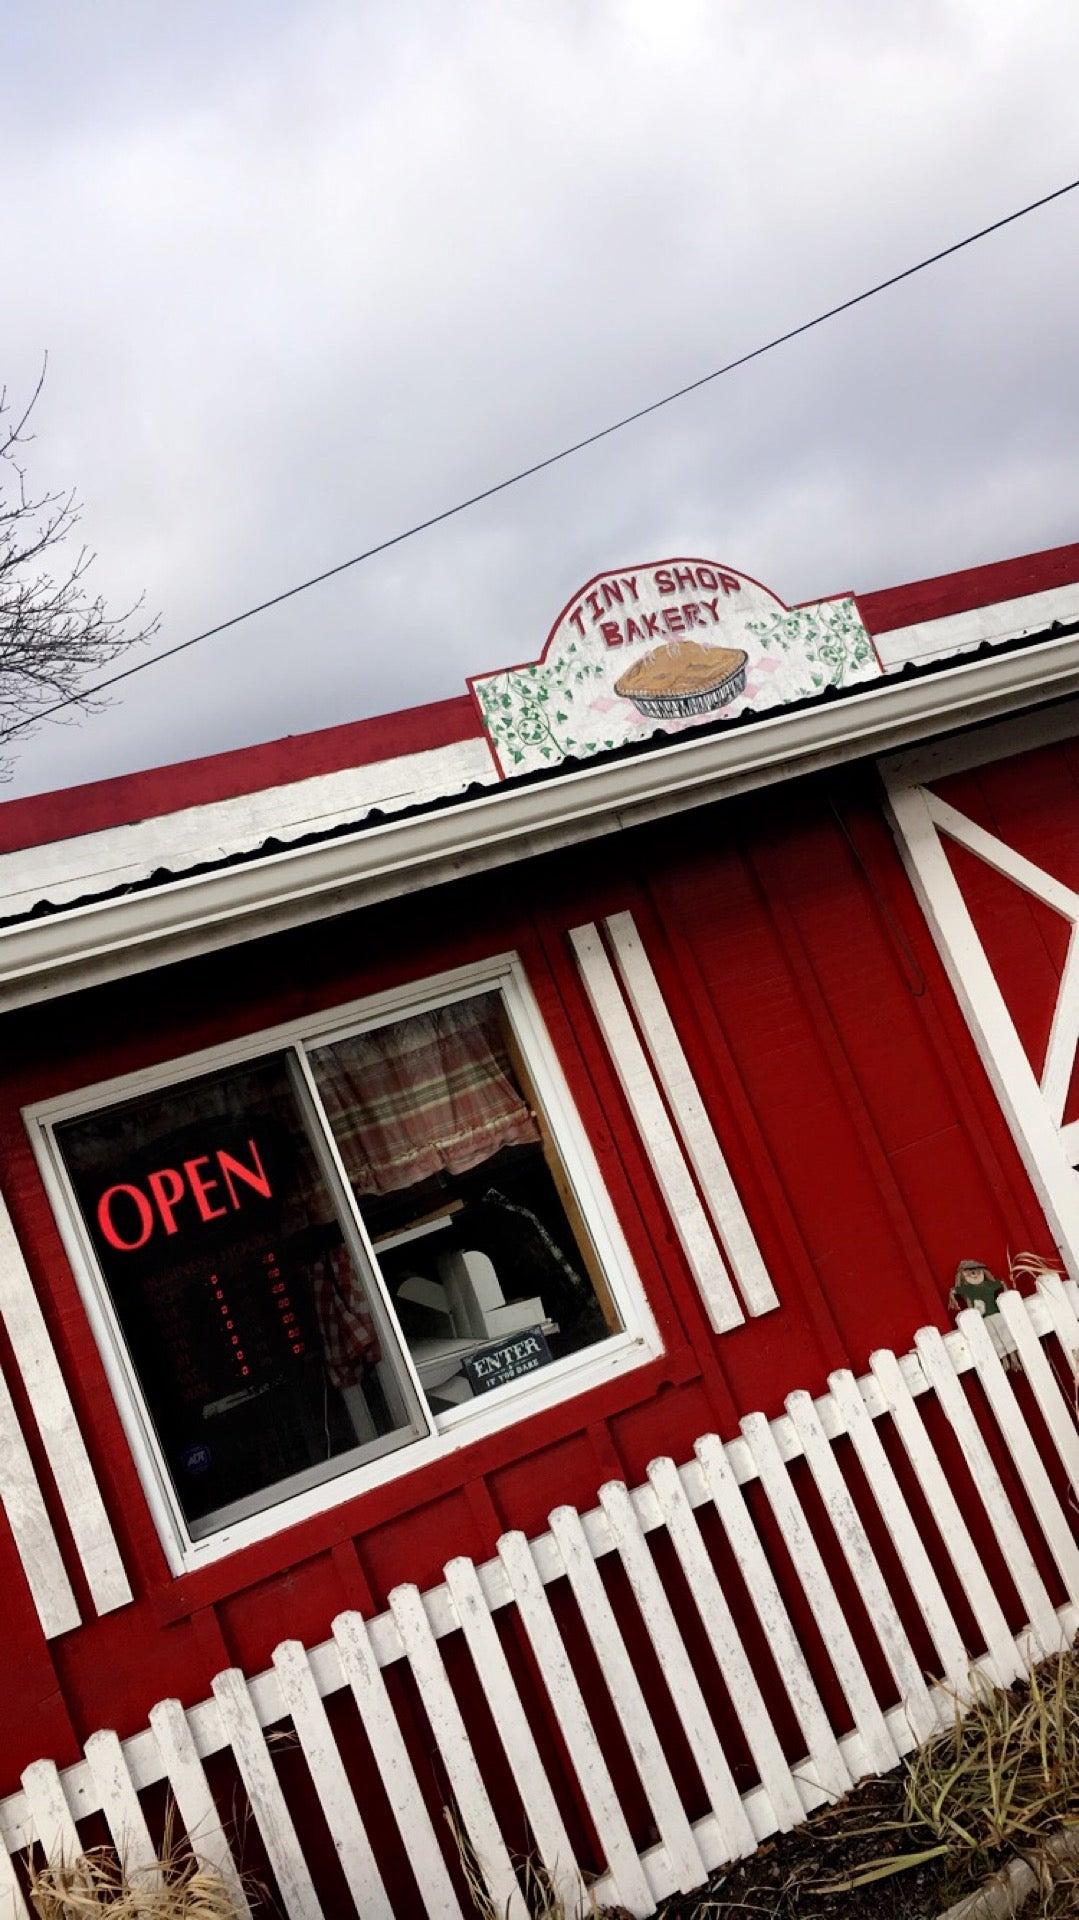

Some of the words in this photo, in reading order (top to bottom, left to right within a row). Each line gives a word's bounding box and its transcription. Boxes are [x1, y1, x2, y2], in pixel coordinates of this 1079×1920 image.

[569, 577, 640, 636] TINY
[653, 566, 742, 597] SHOP
[600, 598, 721, 647] BAKERY
[97, 1137, 273, 1251] OPEN
[473, 1337, 541, 1377] ENTER
